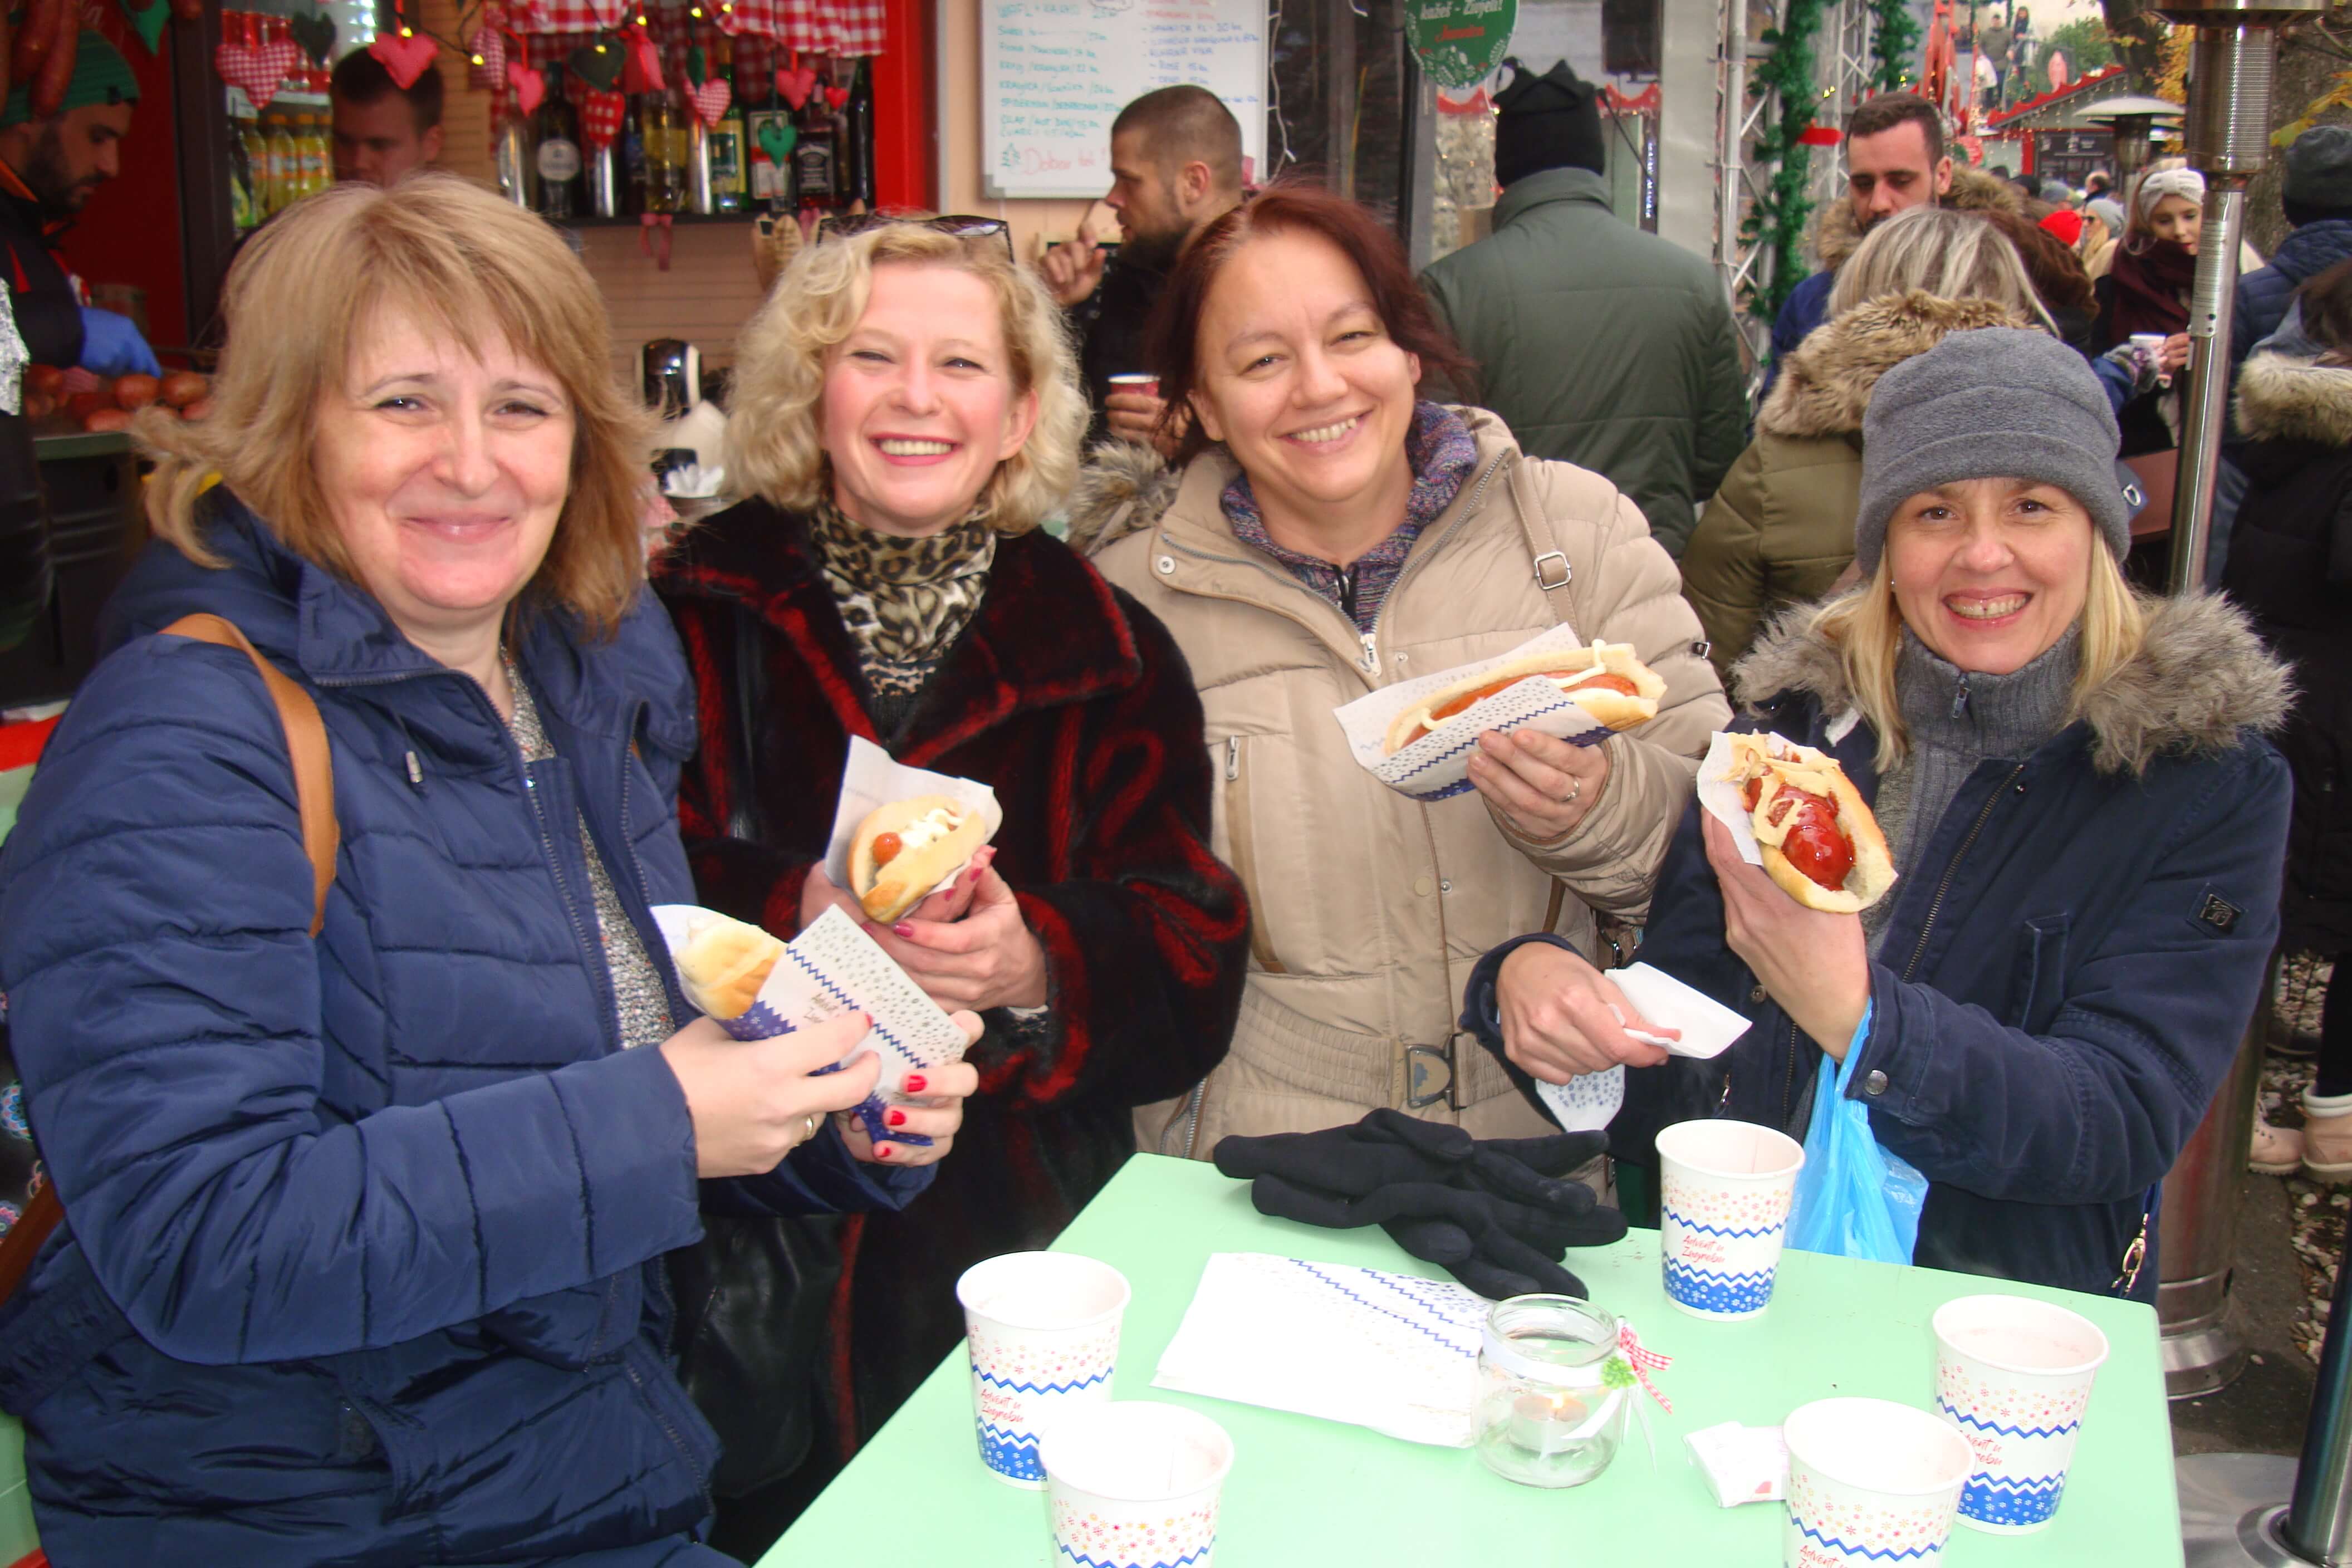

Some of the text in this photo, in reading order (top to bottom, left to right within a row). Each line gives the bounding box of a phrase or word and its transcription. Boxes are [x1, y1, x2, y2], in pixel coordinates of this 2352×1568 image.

[1683, 1235, 1717, 1251] Advent
[1682, 1246, 1726, 1263] Zagrebu
[981, 1389, 1013, 1408] Advent
[982, 1401, 1024, 1423] Zagrebu
[1799, 1545, 1840, 1568] Advent
